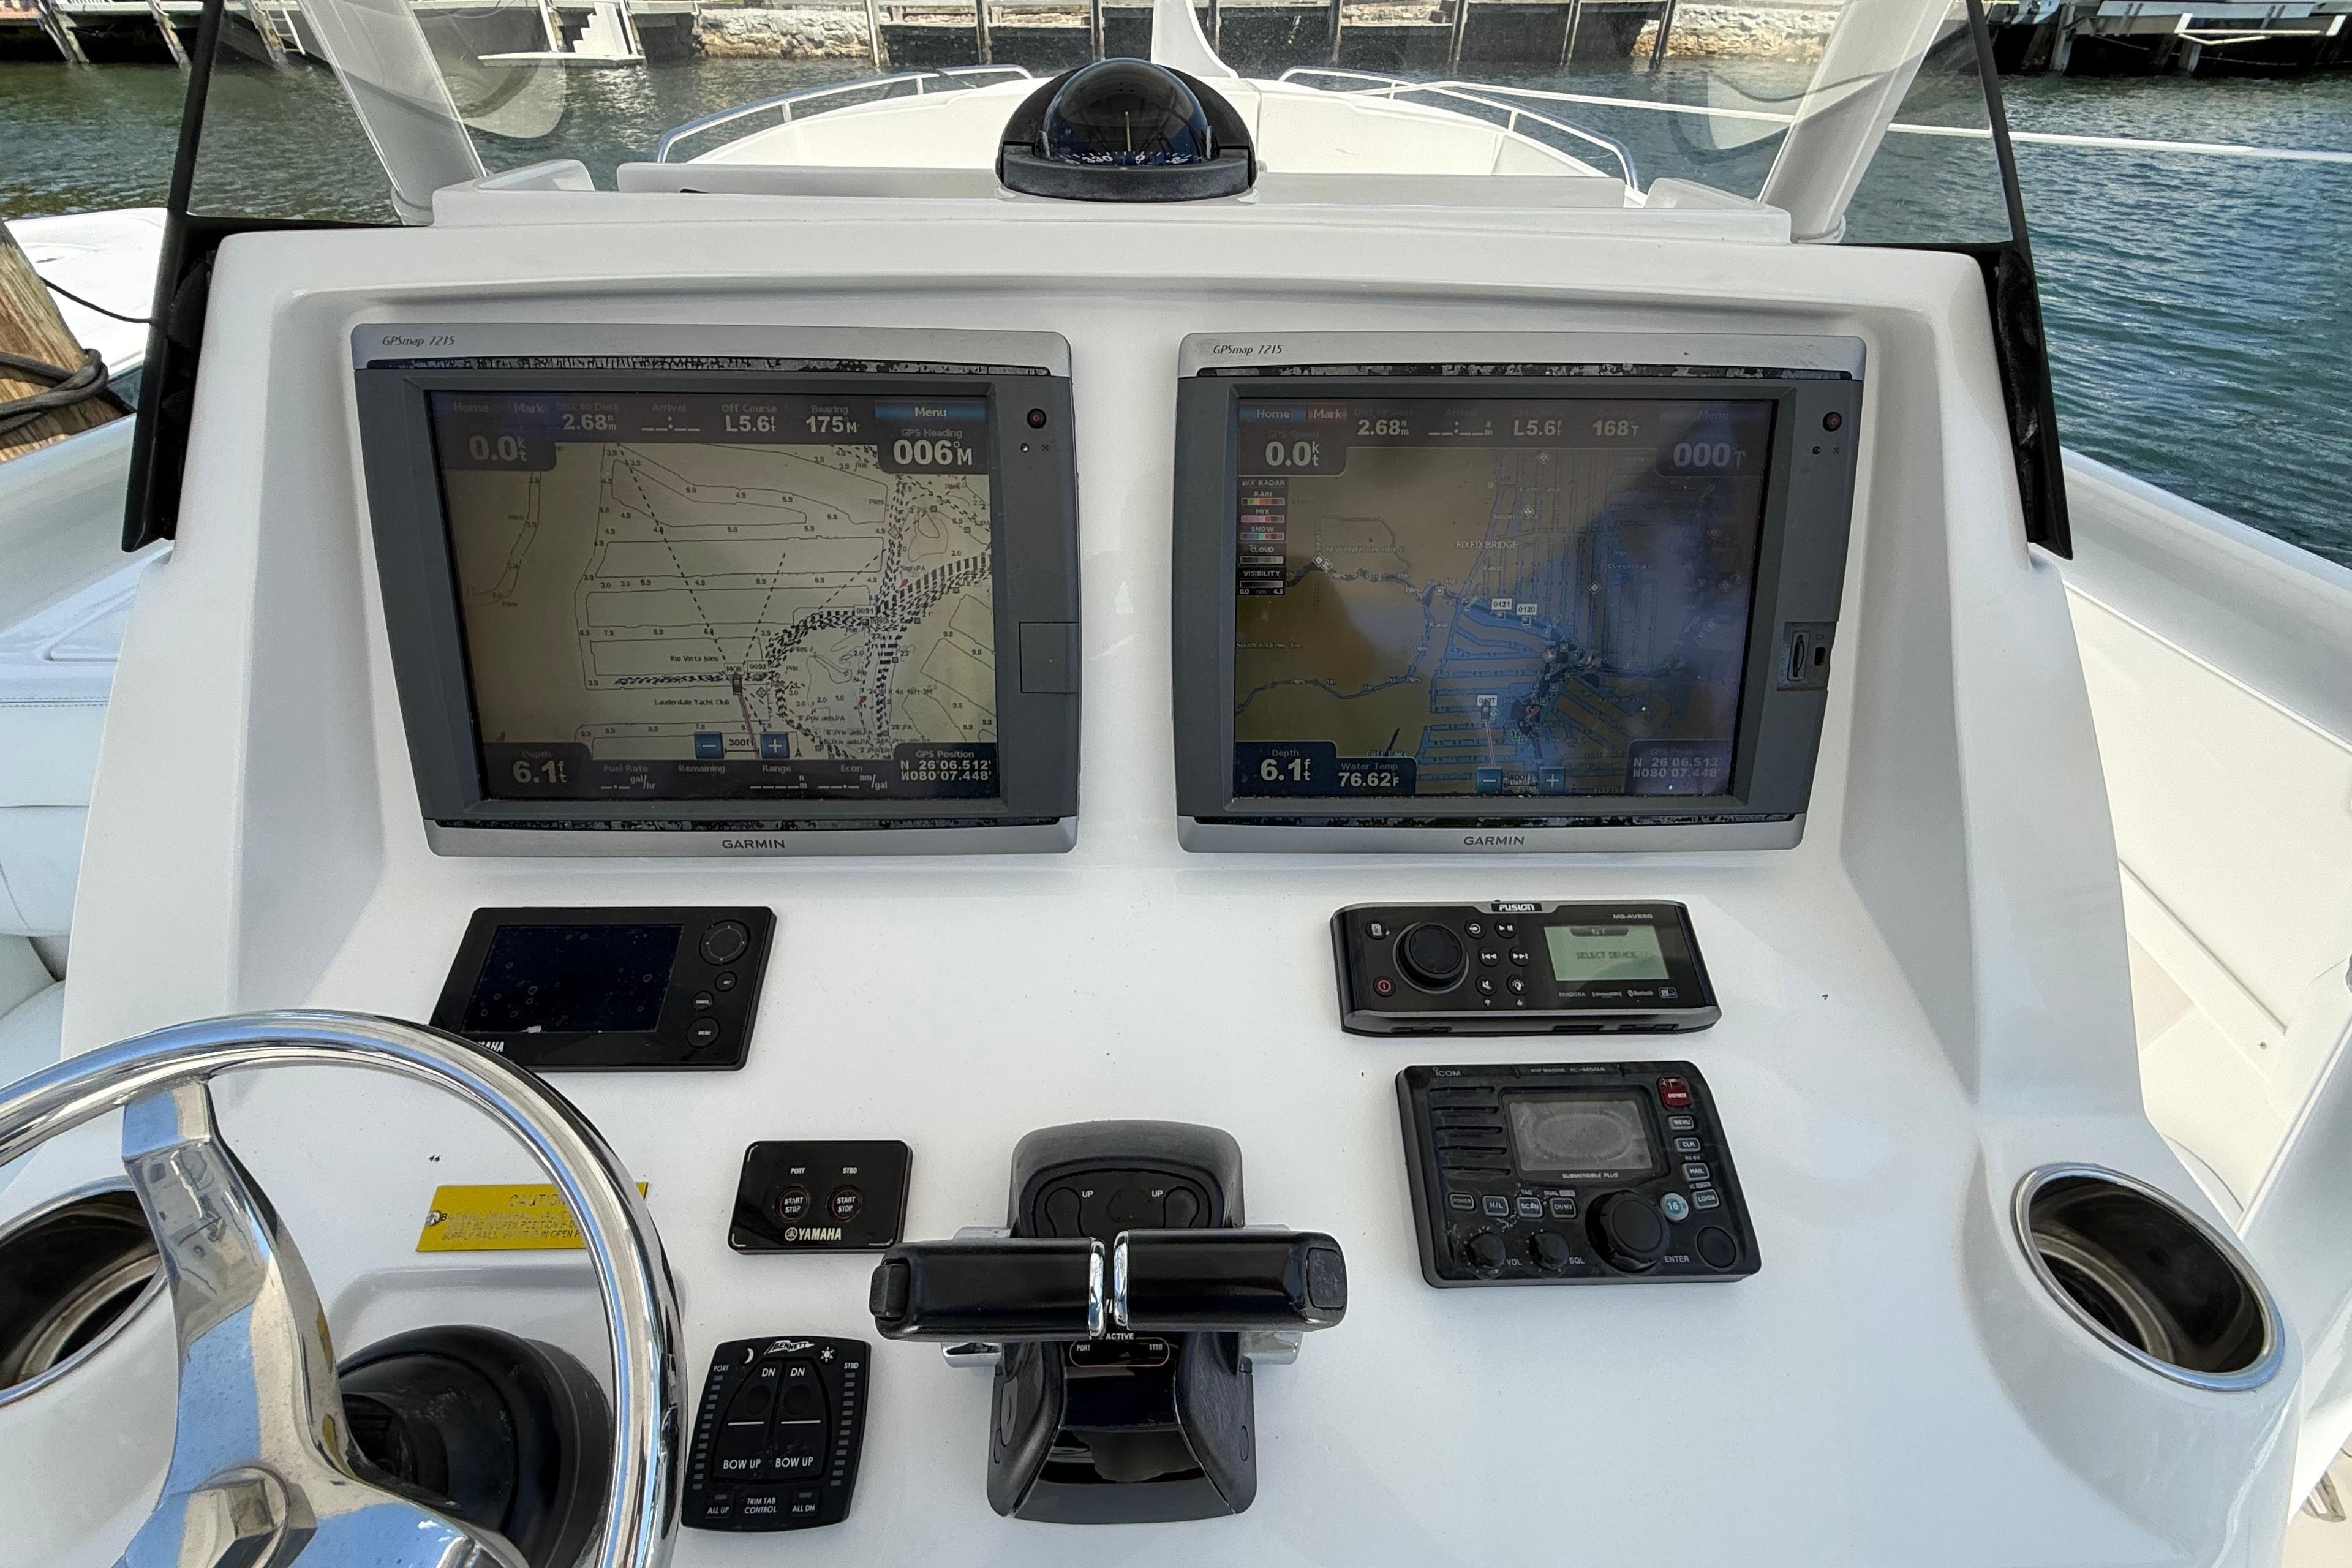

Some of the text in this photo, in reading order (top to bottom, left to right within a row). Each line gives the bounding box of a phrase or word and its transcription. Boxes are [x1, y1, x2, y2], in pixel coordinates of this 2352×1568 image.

[382, 336, 424, 347] GPSmap
[1213, 345, 1283, 355] GPSmap 7215
[453, 402, 544, 413] Home Mark
[652, 402, 687, 412] Arrival
[722, 403, 778, 413] Off Course
[810, 404, 849, 415] Bearing
[914, 407, 947, 417] Menu
[1256, 408, 1343, 419] Home Mark
[1698, 410, 1730, 420] Menu
[562, 413, 608, 431] 2.68
[725, 415, 771, 433] L5.6
[1357, 419, 1401, 435] 2.68
[1513, 419, 1557, 436] L5.6
[901, 428, 963, 439] GPS Heading
[469, 435, 517, 461] 0.0
[1265, 441, 1311, 467] 0.0
[1456, 540, 1518, 549] FIXED BRIDGE
[916, 750, 974, 758] GPS Position
[1272, 749, 1299, 760] Depth
[901, 761, 910, 770] N
[1633, 758, 1642, 766] N
[513, 760, 556, 783] 6.1
[603, 764, 648, 774] Fuel Rate
[678, 764, 726, 775] Remaining
[762, 764, 791, 774] Range
[840, 764, 862, 773] Econ
[1260, 759, 1302, 781] 6.1
[1374, 763, 1398, 772] Temp
[722, 839, 785, 849] GARMIN
[1463, 835, 1525, 846] GARMIN
[1576, 951, 1605, 959] SELECT
[1082, 1190, 1094, 1199] UP
[1152, 1189, 1163, 1198] UP
[784, 1196, 804, 1205] START
[837, 1196, 856, 1204] START
[837, 1205, 853, 1213] STOP
[1667, 1202, 1678, 1210] 16
[799, 1227, 842, 1241] YAMAHA
[761, 1368, 776, 1377] DN
[790, 1367, 805, 1376] DN
[723, 1459, 761, 1470] BOW UP
[775, 1457, 814, 1468] BOW UP
[744, 1506, 777, 1514] CONTROL
